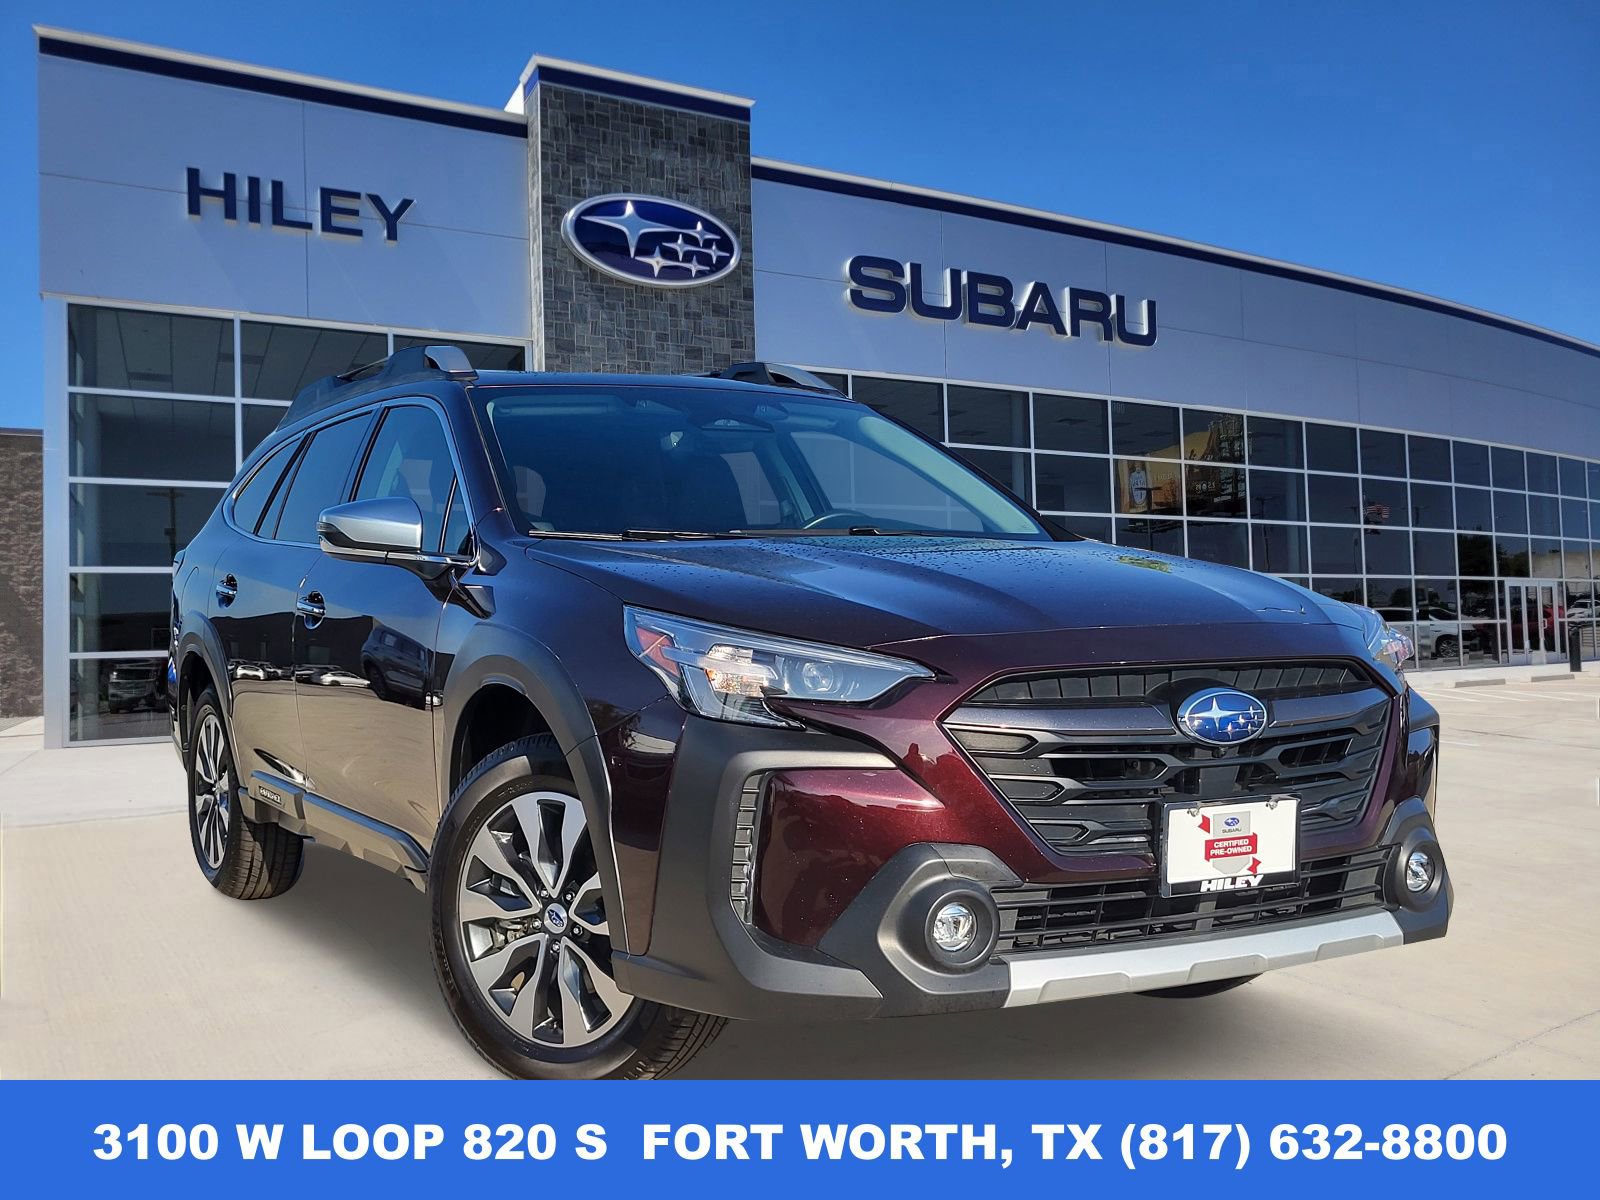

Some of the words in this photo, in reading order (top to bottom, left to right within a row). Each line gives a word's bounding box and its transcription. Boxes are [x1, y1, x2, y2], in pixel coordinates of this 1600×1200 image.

[186, 166, 416, 242] HILEY
[848, 254, 1158, 347] SUBARU
[1209, 845, 1253, 857] PRE-OWNED
[1213, 838, 1250, 849] CERTIFIED
[1200, 874, 1265, 893] HILEY
